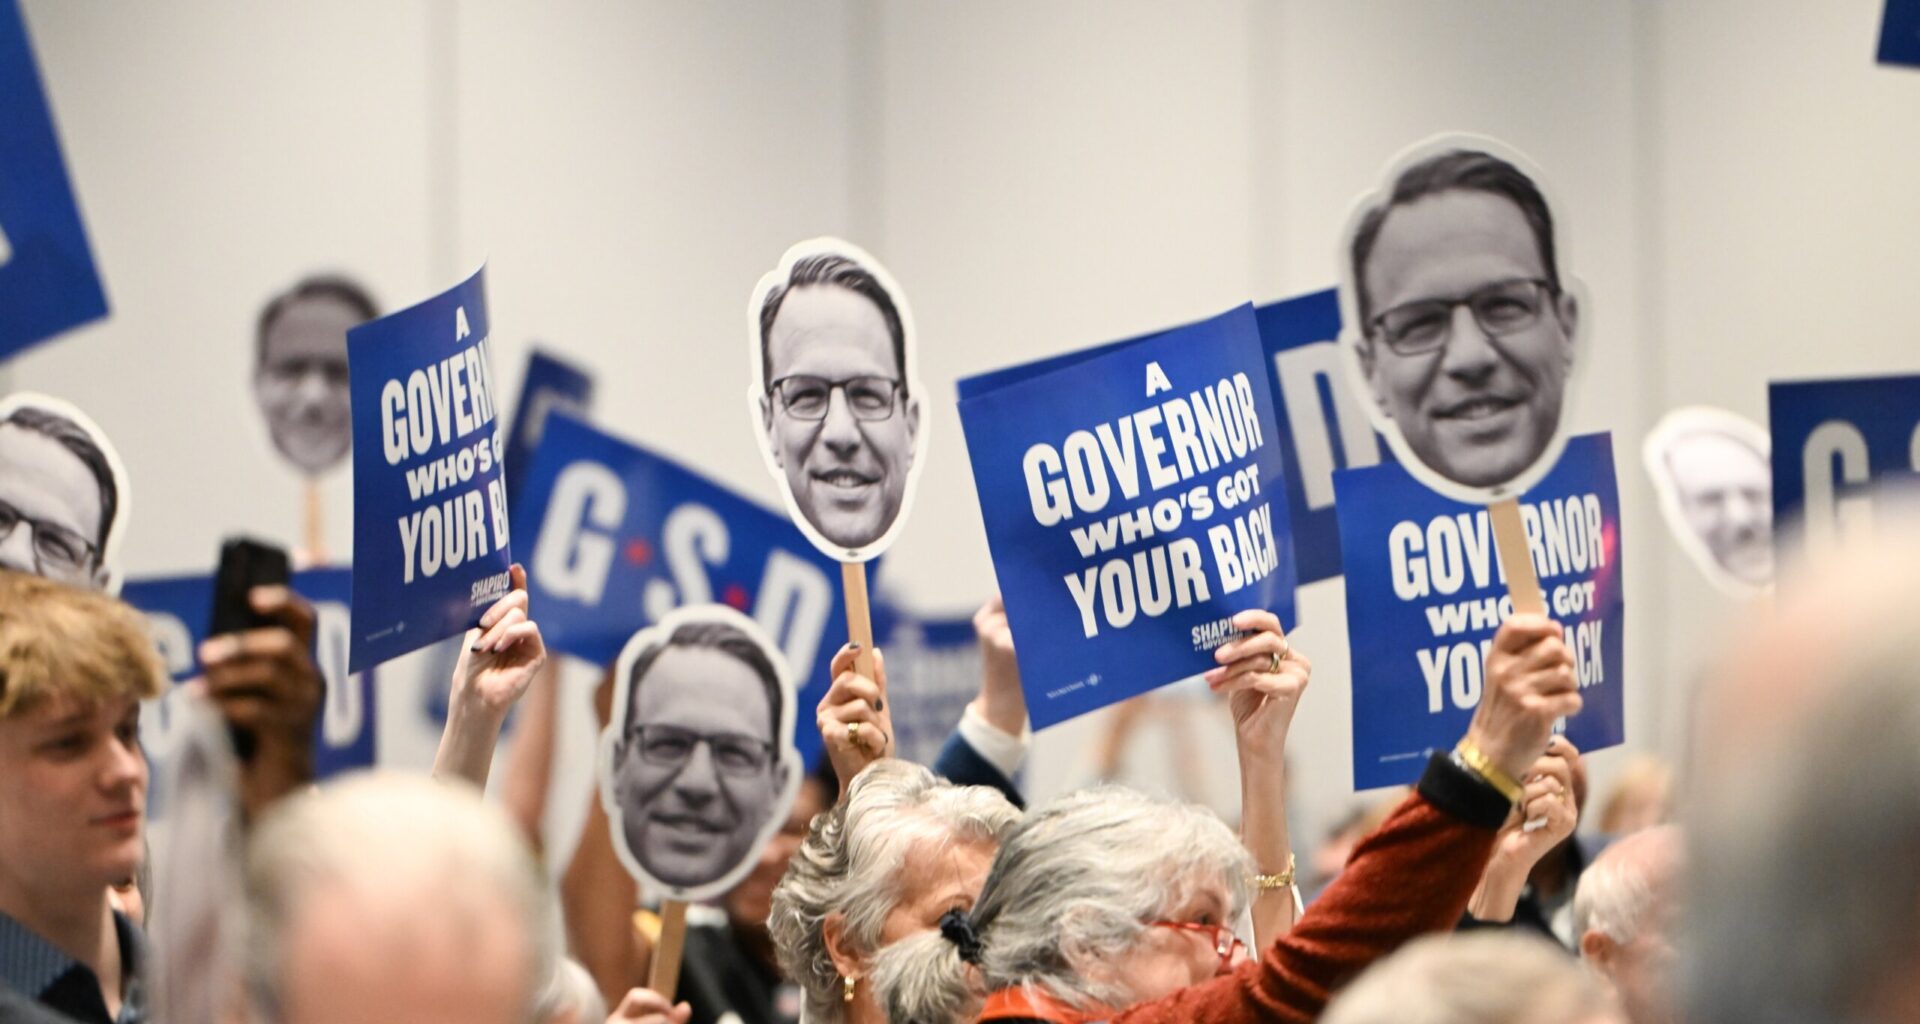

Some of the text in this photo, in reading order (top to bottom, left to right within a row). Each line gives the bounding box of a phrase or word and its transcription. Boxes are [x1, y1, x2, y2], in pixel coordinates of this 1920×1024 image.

[456, 306, 470, 342] A
[1146, 361, 1172, 398] A
[406, 438, 492, 501] WHO'S
[1022, 372, 1264, 527] GOVERNOR
[398, 489, 488, 585] YOUR
[1070, 463, 1260, 558] WHO'S GOT
[1063, 502, 1278, 639] YOUR BACK
[1388, 493, 1605, 601] GOVRNOR
[471, 570, 510, 602] SHAPIRO
[1553, 581, 1596, 617] GOT
[1191, 616, 1243, 645] SHAPI
